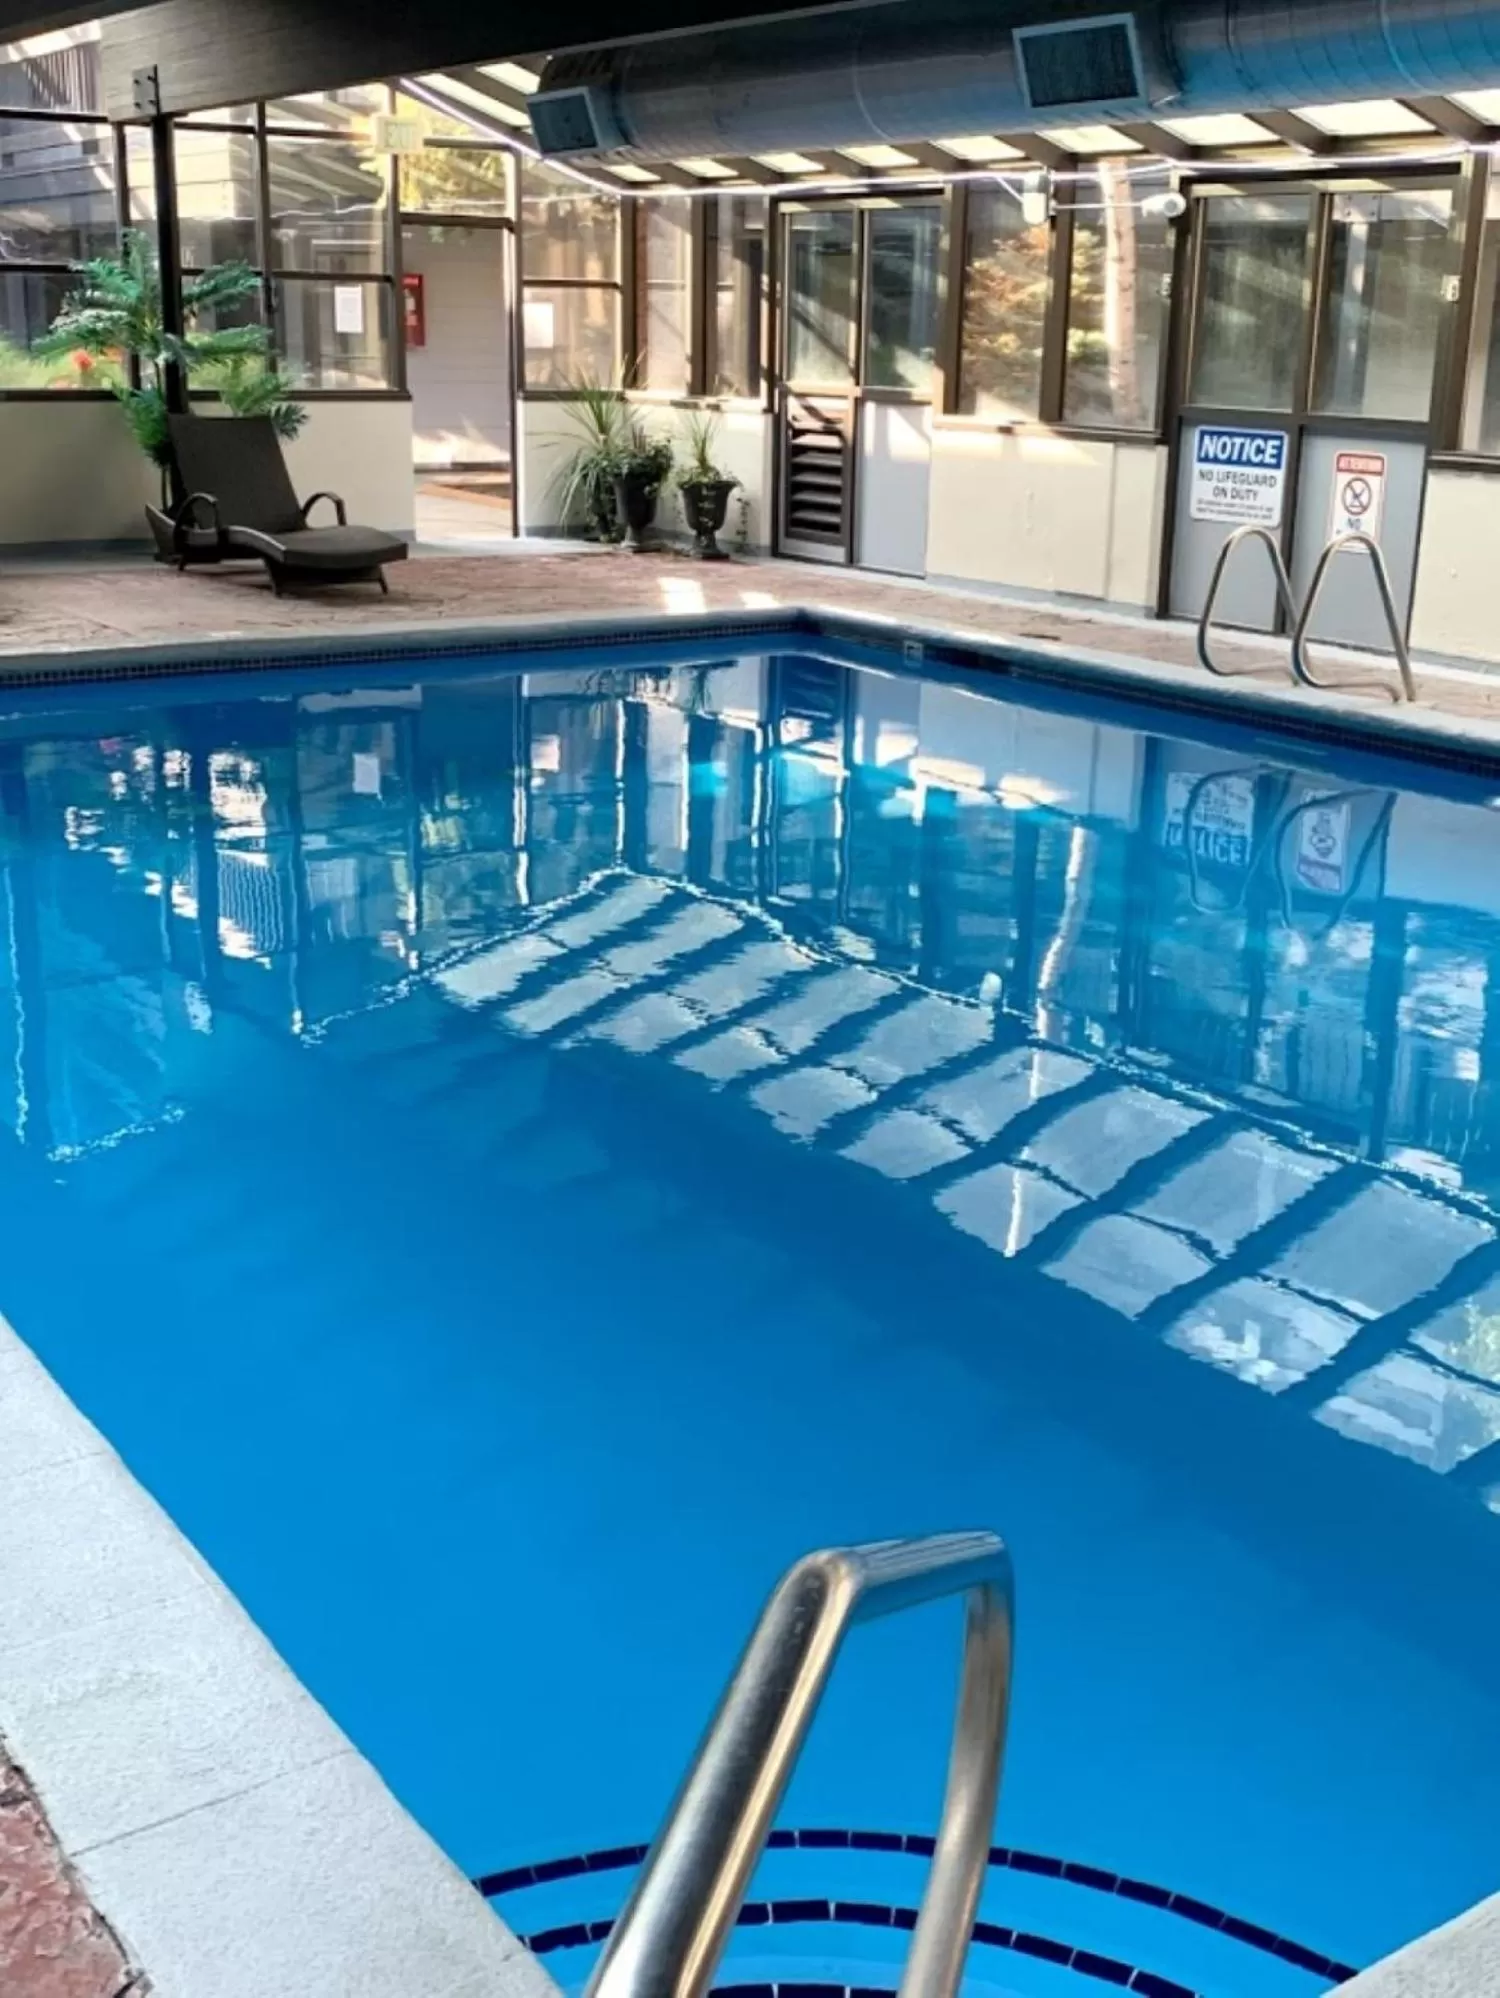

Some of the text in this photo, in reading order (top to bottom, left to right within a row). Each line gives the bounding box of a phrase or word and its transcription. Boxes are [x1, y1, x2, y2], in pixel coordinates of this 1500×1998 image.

[1200, 434, 1281, 464] NOTICE
[1199, 469, 1277, 488] NO LIFEGUARD
[1213, 485, 1258, 501] ON DUTY
